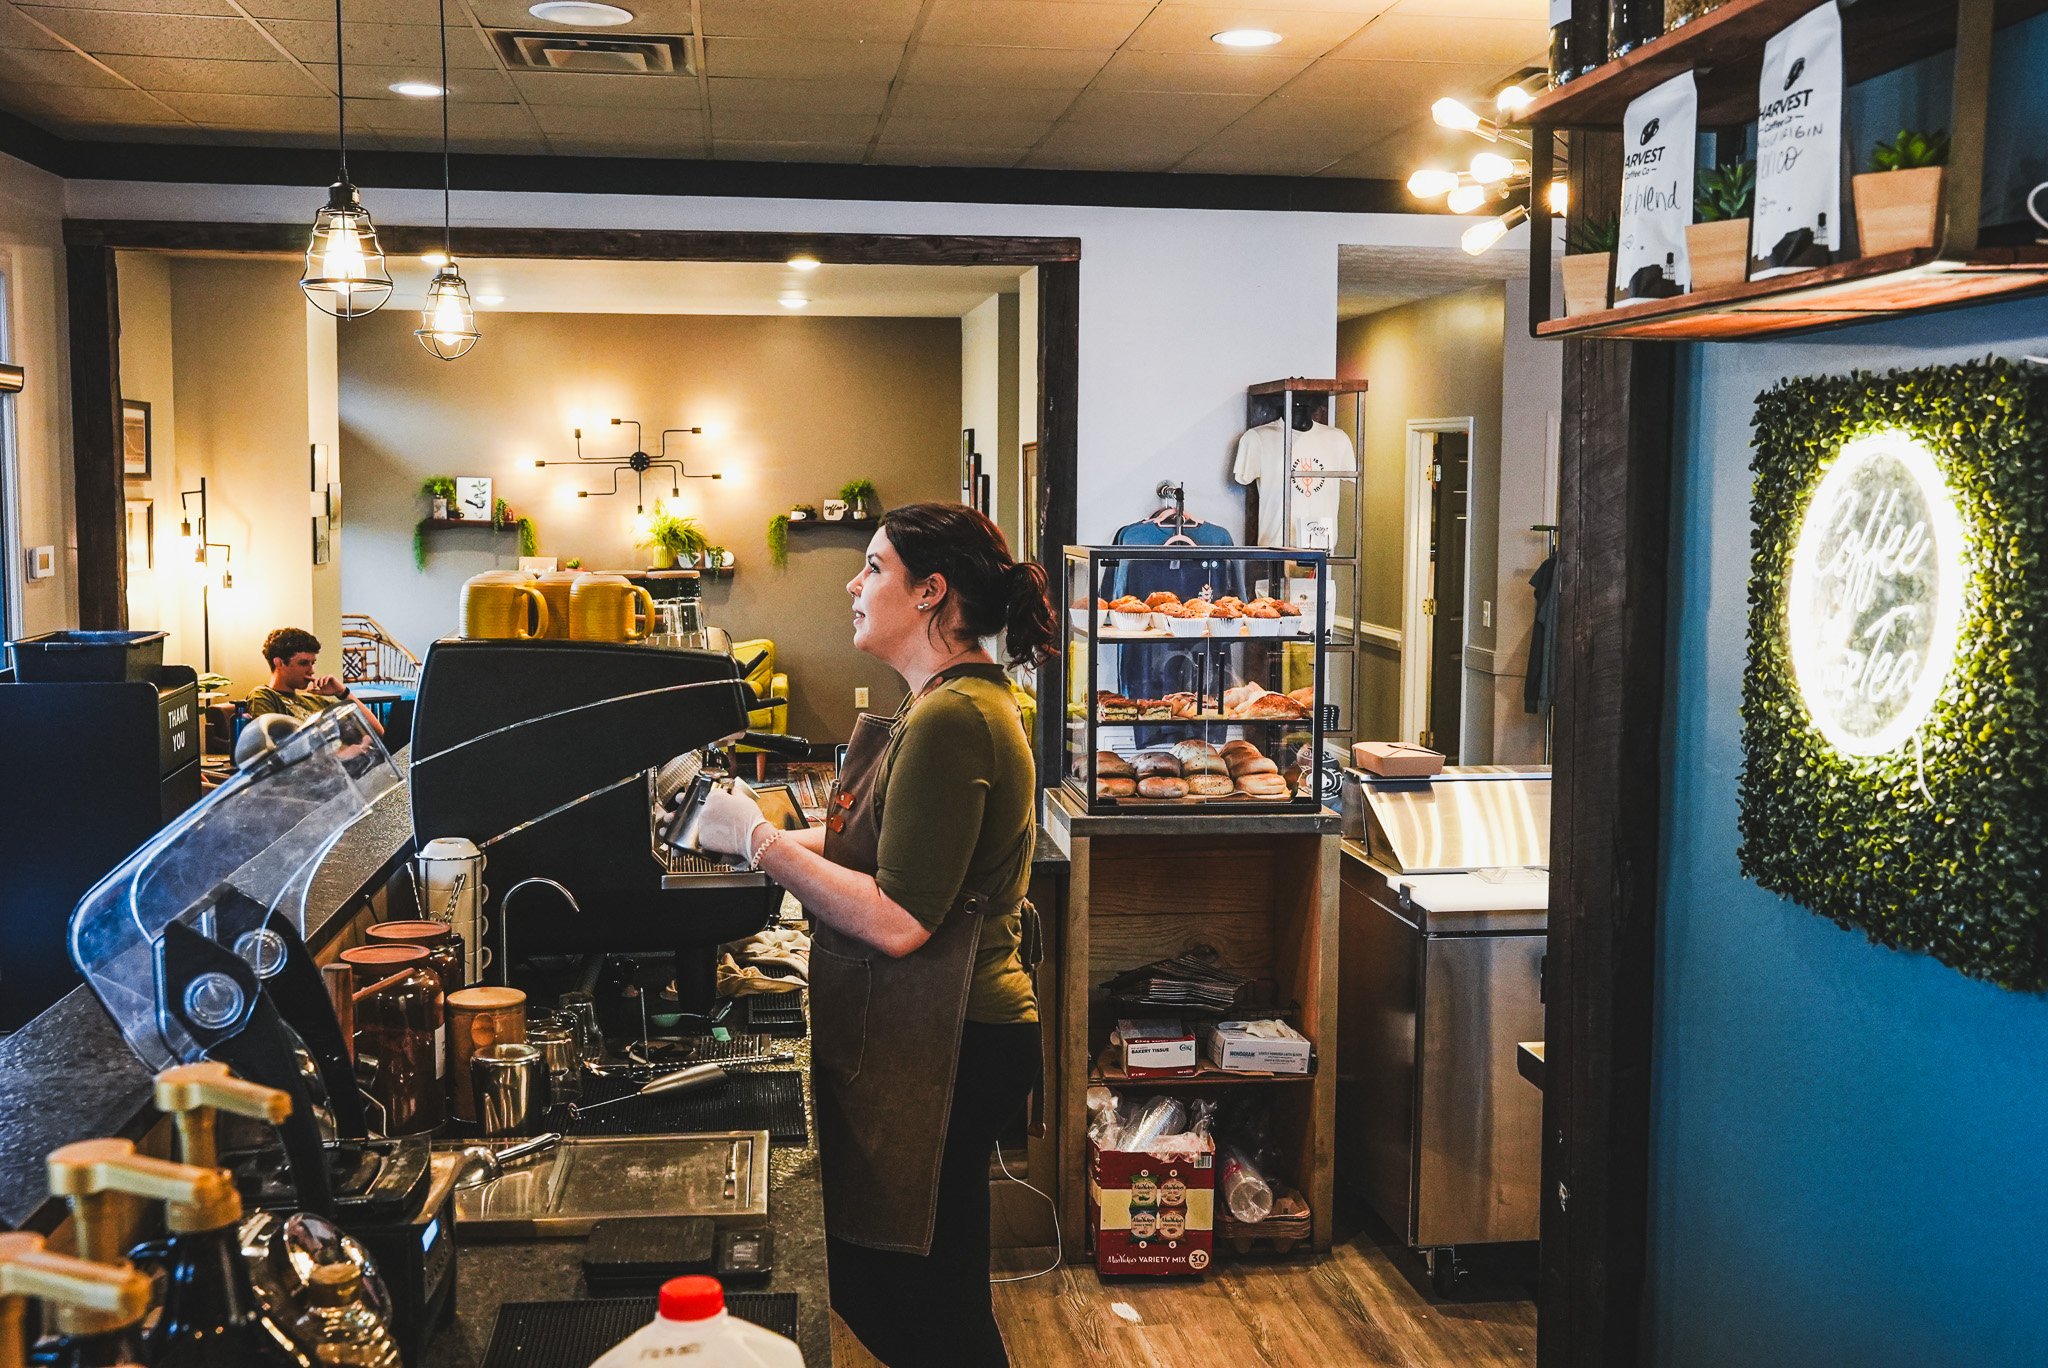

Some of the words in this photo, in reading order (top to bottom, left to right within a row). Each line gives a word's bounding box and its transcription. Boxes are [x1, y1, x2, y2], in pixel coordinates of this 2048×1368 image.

[1759, 88, 1814, 121] HARVEST
[1625, 146, 1666, 168] ARVEST
[1634, 180, 1681, 215] blend
[824, 504, 843, 516] coffee
[1813, 487, 1931, 613] Coffee
[1858, 604, 1920, 703] Tea
[168, 703, 189, 729] THANK
[172, 730, 186, 753] YOU
[1131, 1047, 1151, 1055] BAKERY
[1191, 1253, 1207, 1263] 30
